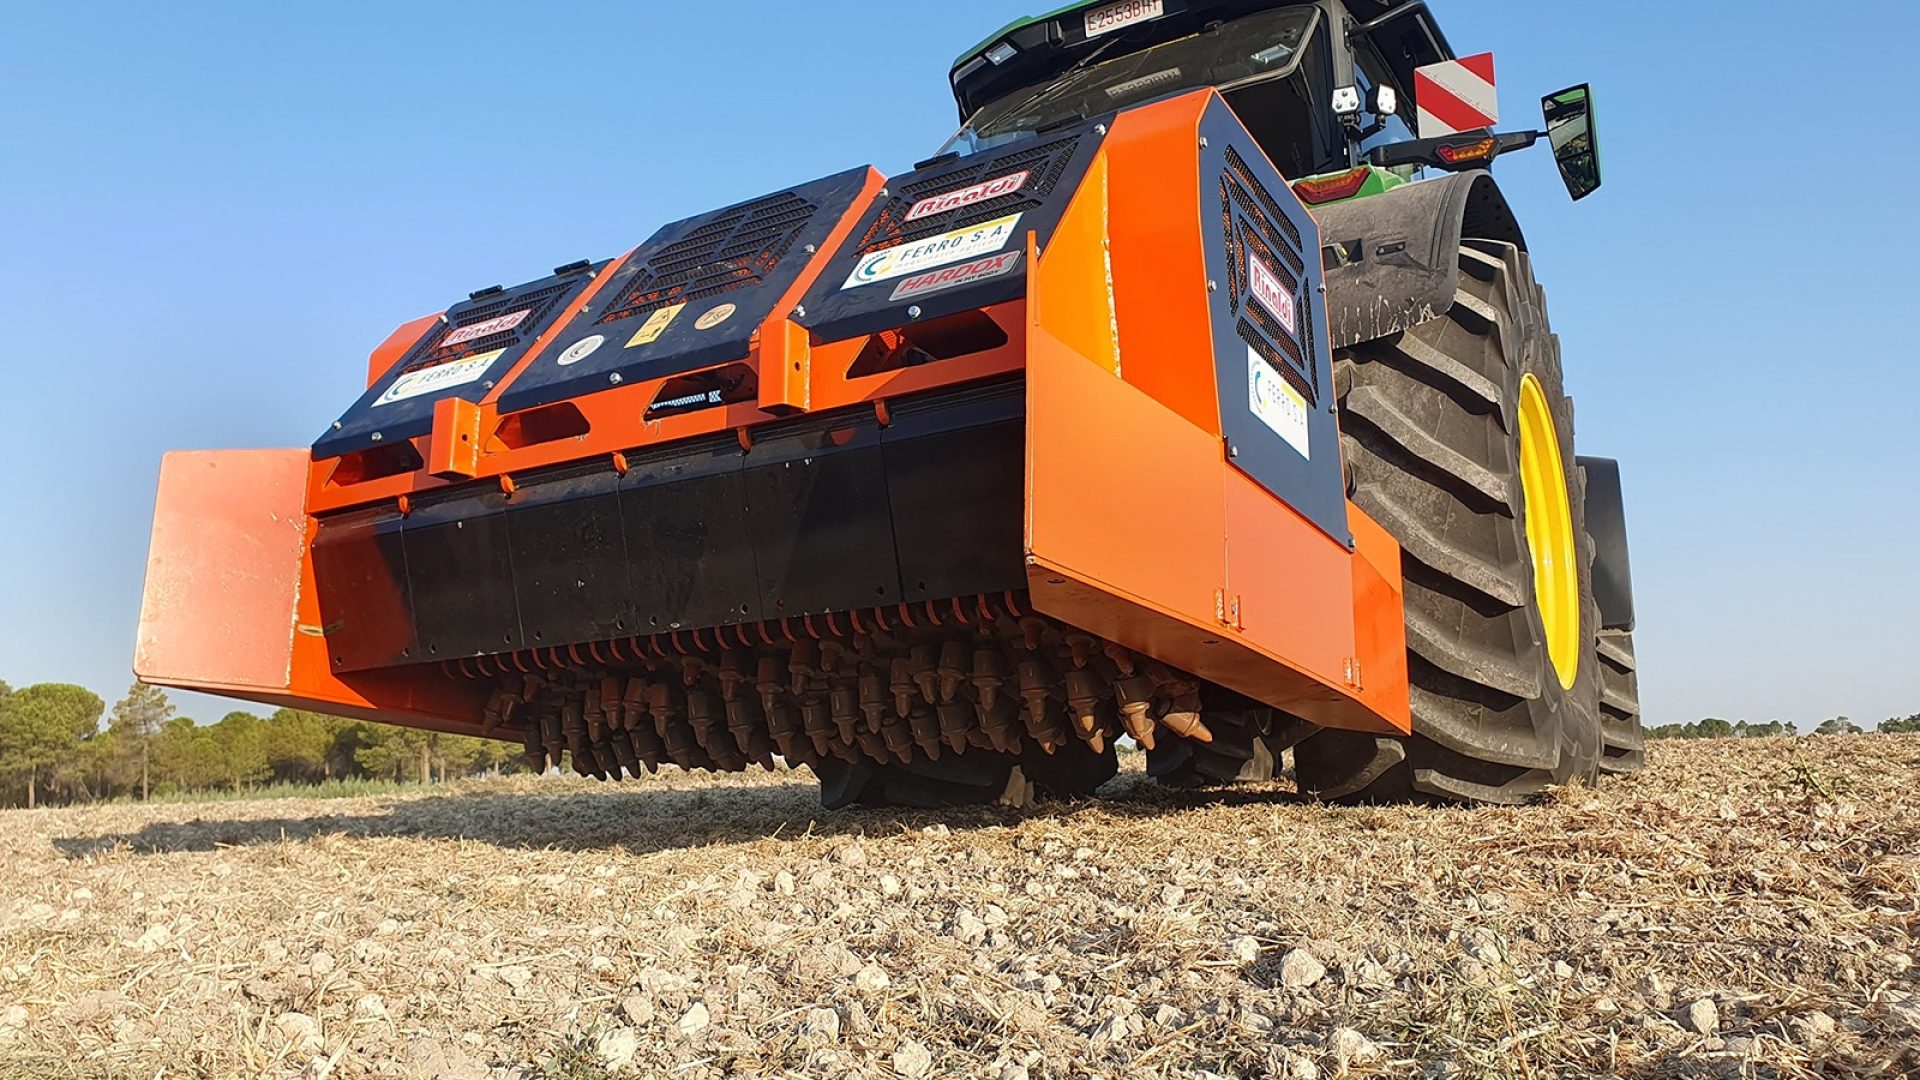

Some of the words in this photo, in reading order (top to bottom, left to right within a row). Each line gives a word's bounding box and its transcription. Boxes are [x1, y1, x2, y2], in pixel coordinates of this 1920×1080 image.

[916, 176, 1016, 215] Rinaldi
[900, 235, 963, 262] FERRO
[899, 254, 1011, 293] HARDOX
[1253, 266, 1292, 324] Rinaldi
